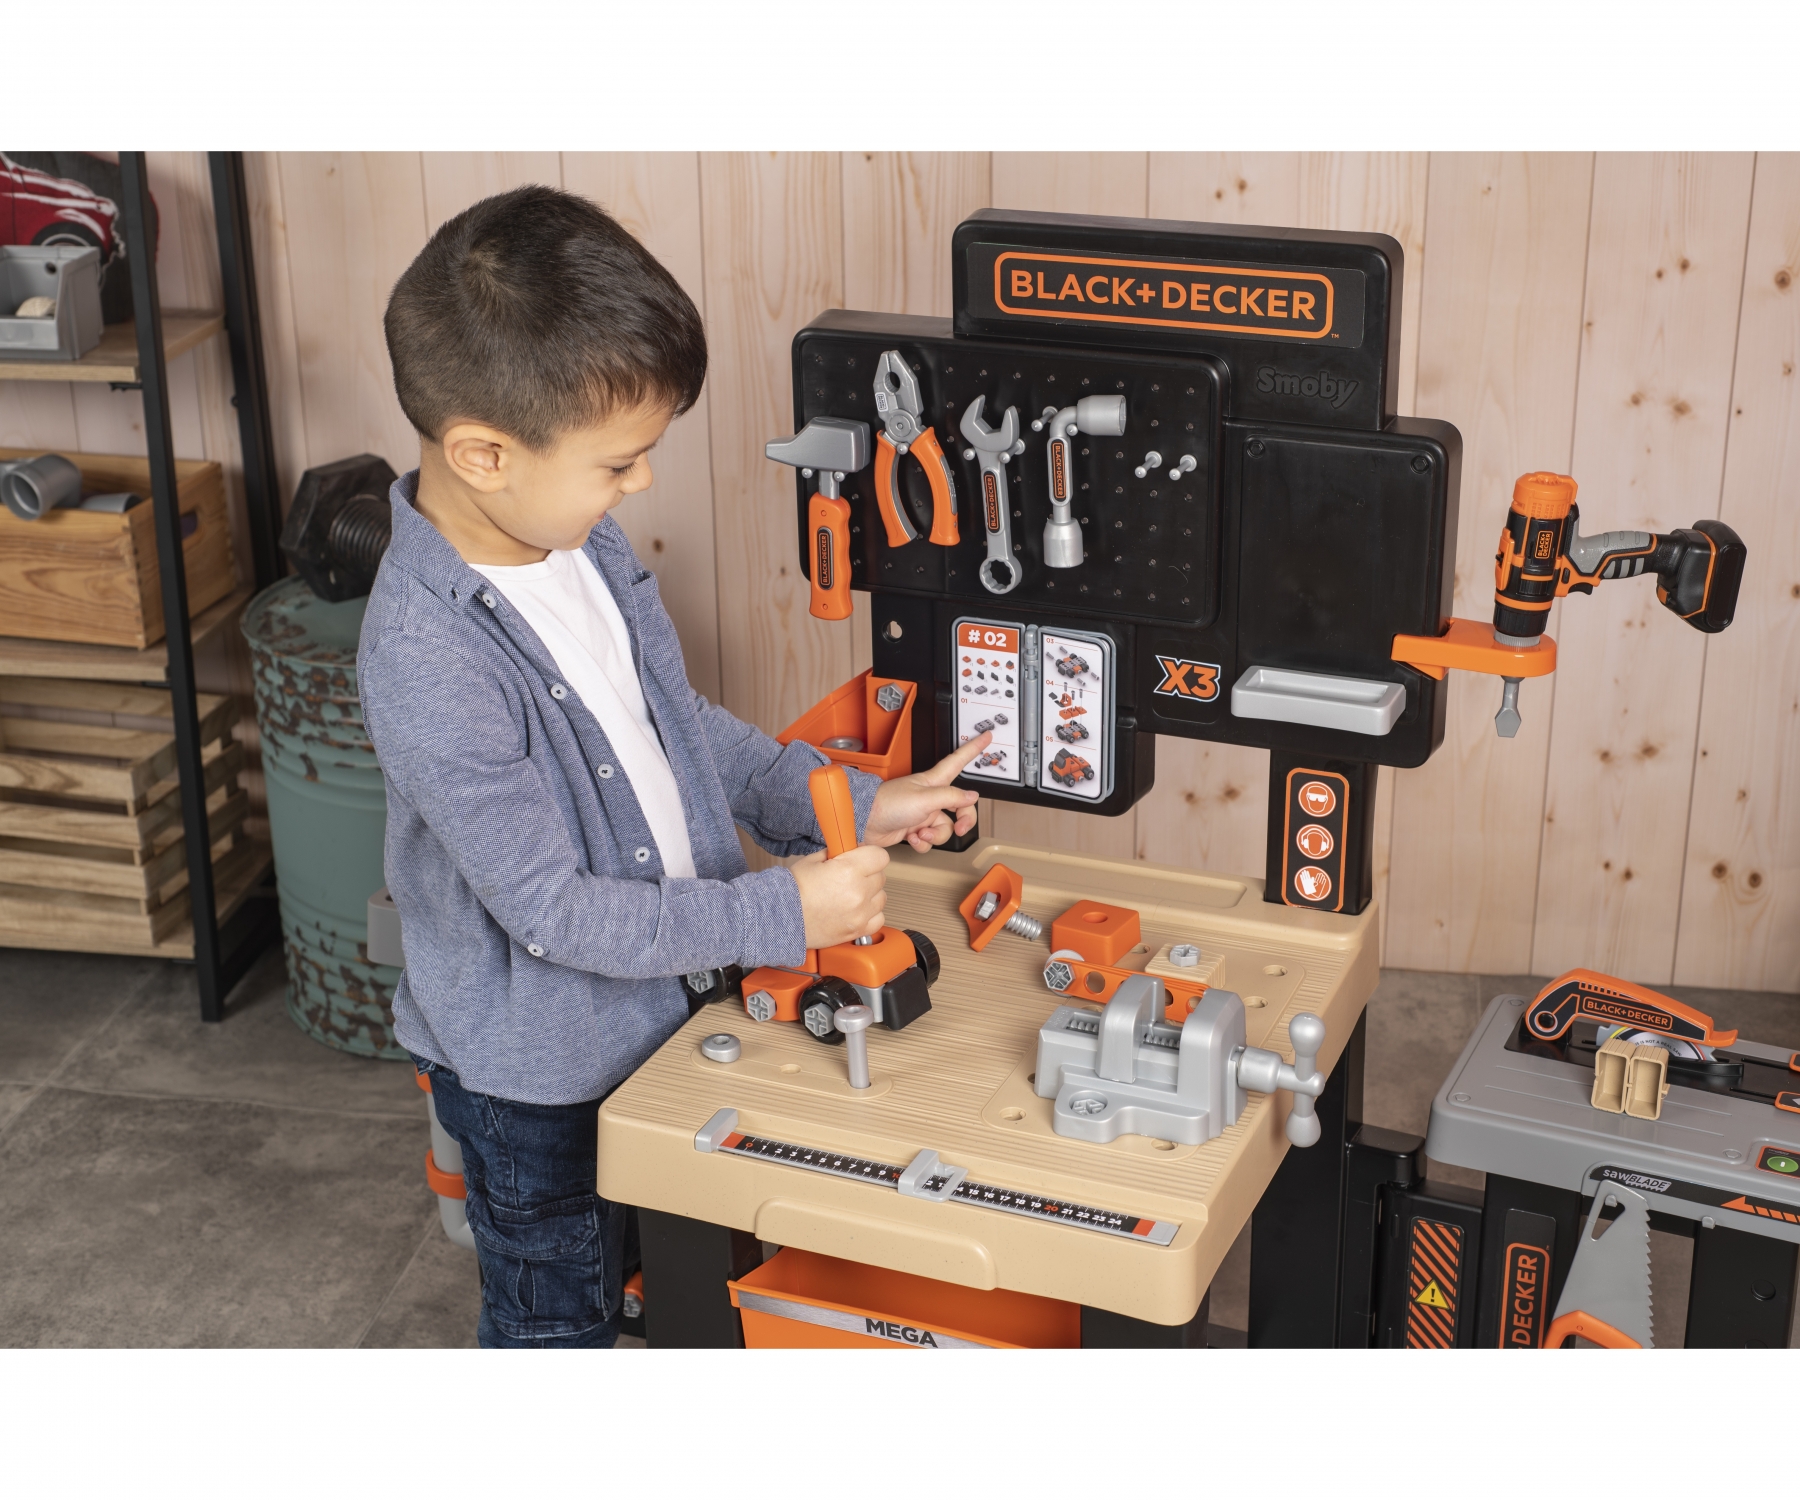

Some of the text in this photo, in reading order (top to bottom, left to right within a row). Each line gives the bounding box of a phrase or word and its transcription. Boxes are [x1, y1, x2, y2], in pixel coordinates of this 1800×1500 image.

[1010, 269, 1316, 321] BLACK+DECKER
[1256, 366, 1359, 410] Smoby
[1055, 446, 1063, 496] BLACK+DECKER
[987, 477, 998, 527] BLACK+DECKER
[984, 631, 1007, 648] 02
[1159, 658, 1218, 699] X3
[1586, 1001, 1668, 1026] BLACK+DECKER
[1044, 1204, 1059, 1212] 20
[1076, 1211, 1090, 1219] 22
[1092, 1214, 1106, 1222] 23
[1108, 1217, 1122, 1225] 24
[1511, 1254, 1538, 1347] DECKER
[865, 1317, 939, 1349] MEGA
